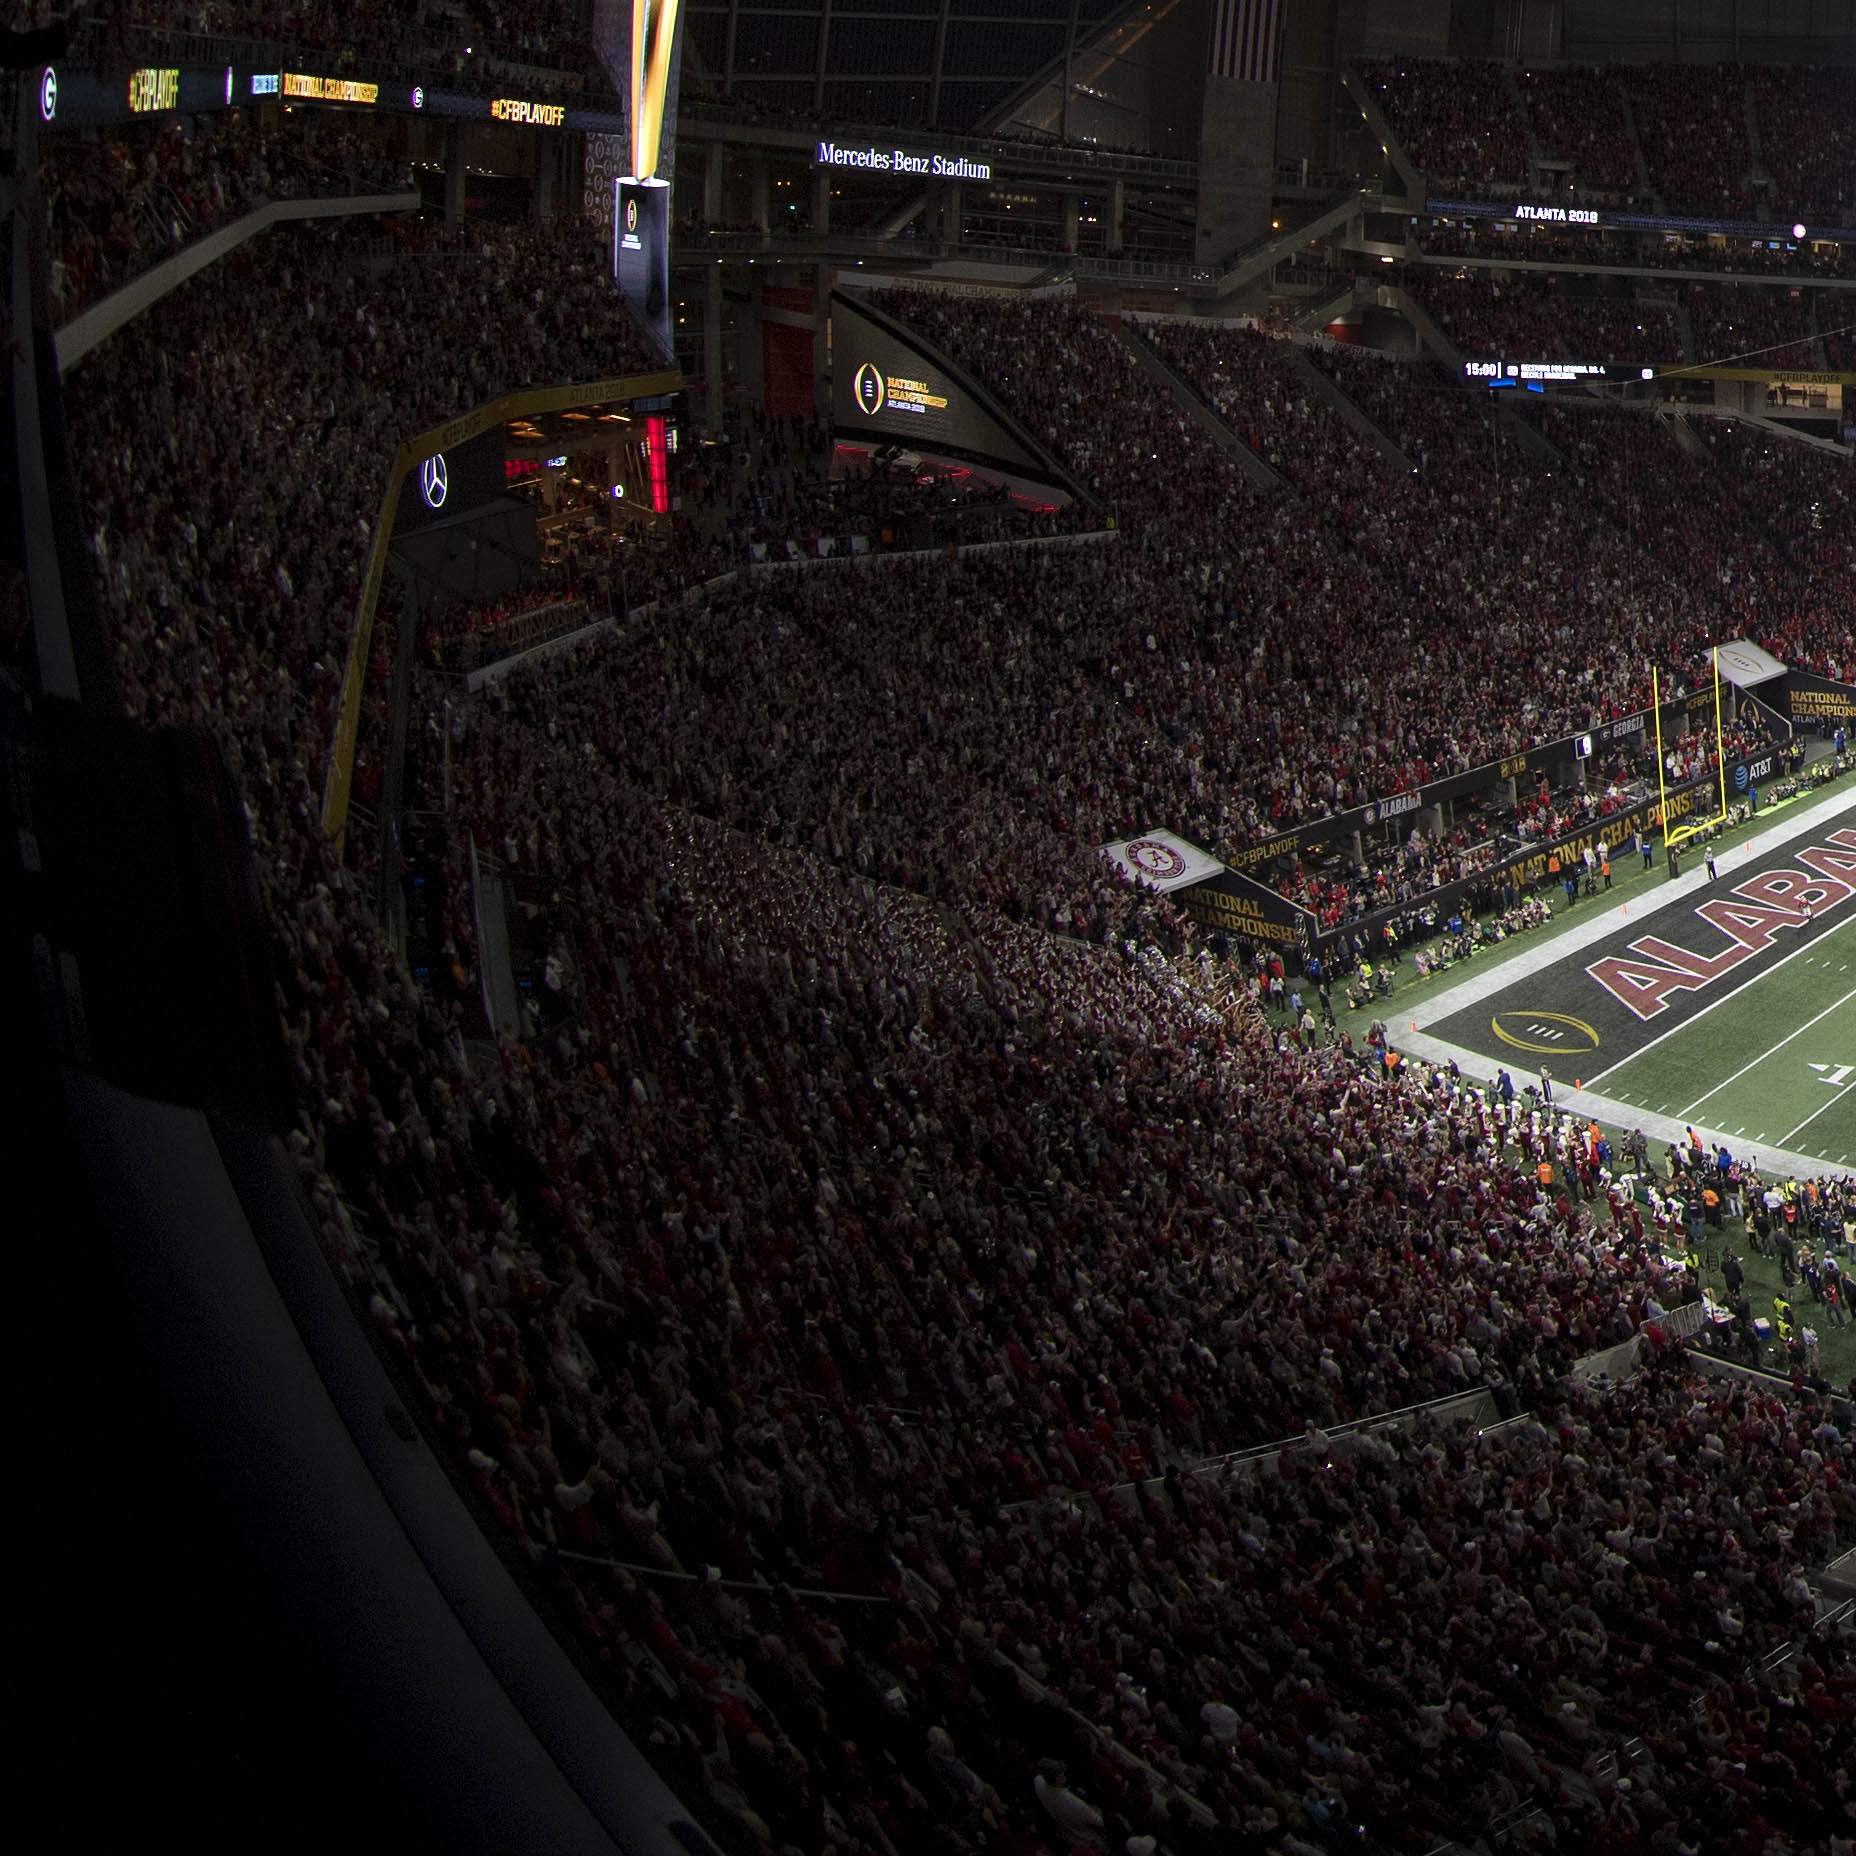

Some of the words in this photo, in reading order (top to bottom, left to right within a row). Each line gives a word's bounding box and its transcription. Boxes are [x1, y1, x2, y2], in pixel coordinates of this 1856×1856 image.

[491, 99, 565, 126] #CFBPLAYOFF
[819, 142, 929, 173] Mercedes-Benz
[932, 155, 991, 179] Stadium
[1515, 206, 1566, 222] ATLANTA
[1568, 209, 1598, 223] 2018
[1465, 362, 1497, 376] 15:00
[1773, 372, 1841, 384] #CFBPLAYOFF
[887, 376, 929, 394] NATIONAL
[1790, 691, 1851, 705] NATIONAL
[1612, 716, 1644, 738] GEORGIA
[1749, 757, 1773, 780] AT&T
[1379, 793, 1422, 820] ALABAMA
[1230, 835, 1300, 868] #CFBPLAYOFF
